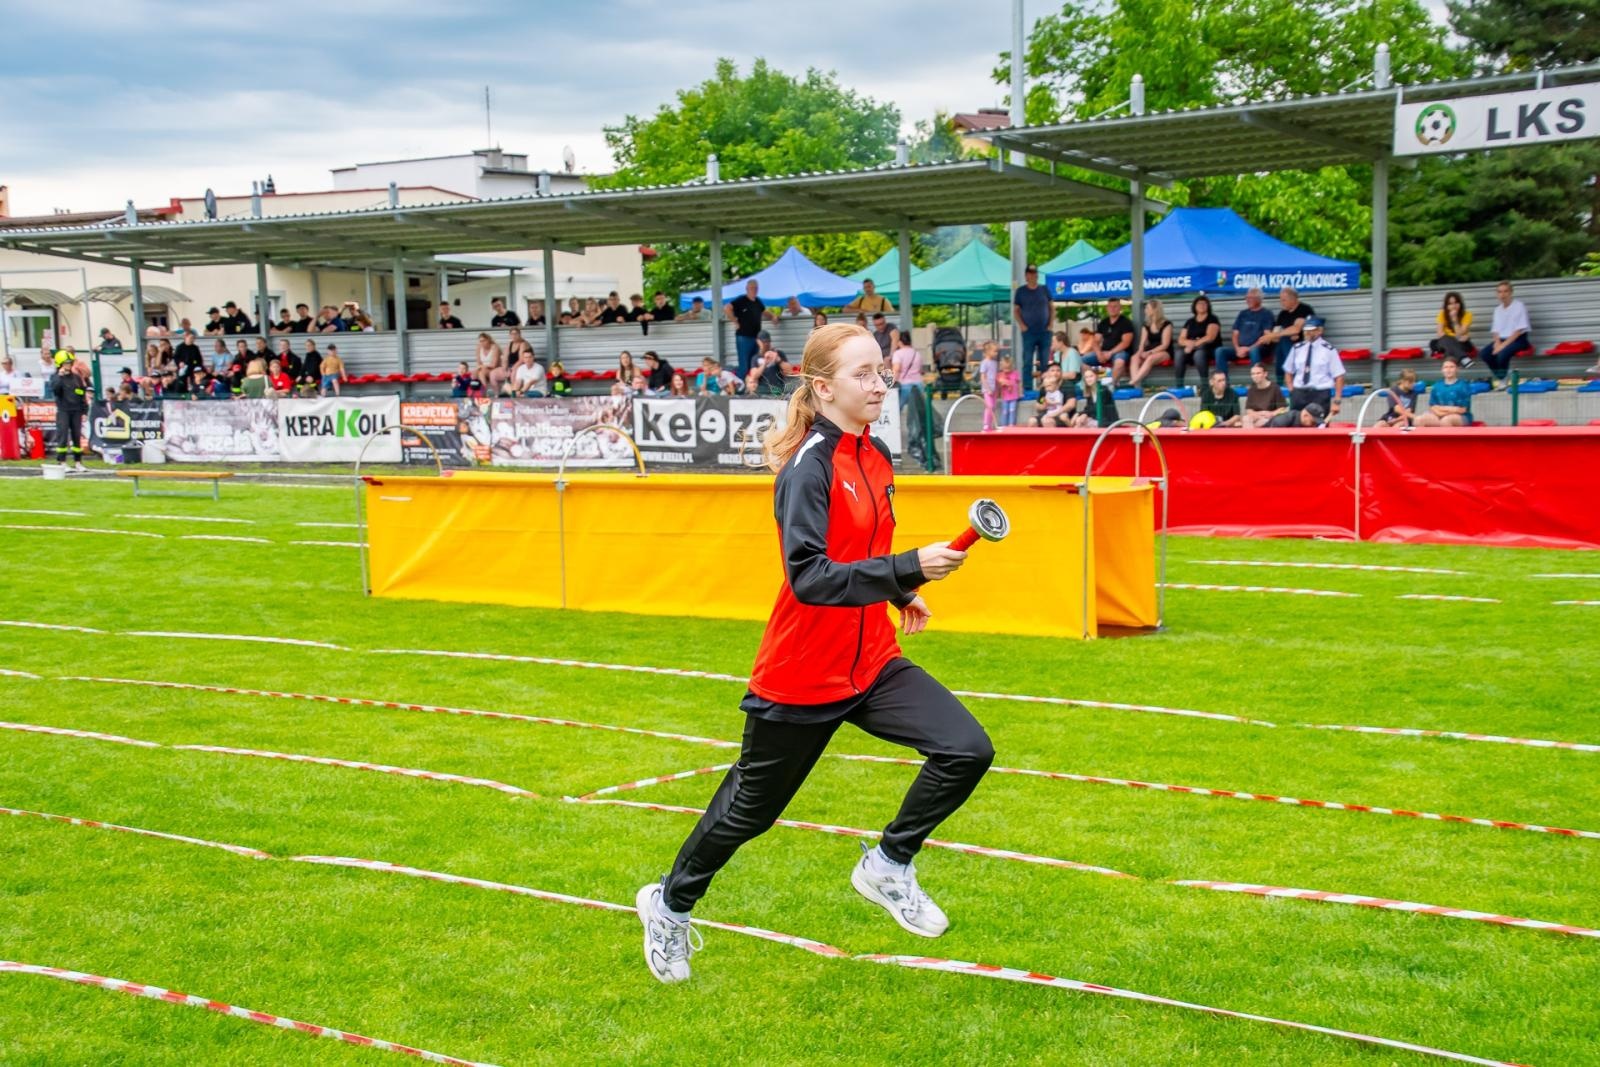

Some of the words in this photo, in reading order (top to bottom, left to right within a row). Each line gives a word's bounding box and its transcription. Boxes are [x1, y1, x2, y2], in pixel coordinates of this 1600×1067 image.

[1486, 97, 1586, 141] LKS
[1071, 280, 1104, 294] GMINA
[1106, 275, 1192, 292] KRZYANOWICE
[1234, 272, 1268, 289] GMINA
[1269, 270, 1348, 288] KRZYŻANOWICE
[403, 405, 456, 418] KREWETKA
[285, 409, 391, 438] KERAKOLL
